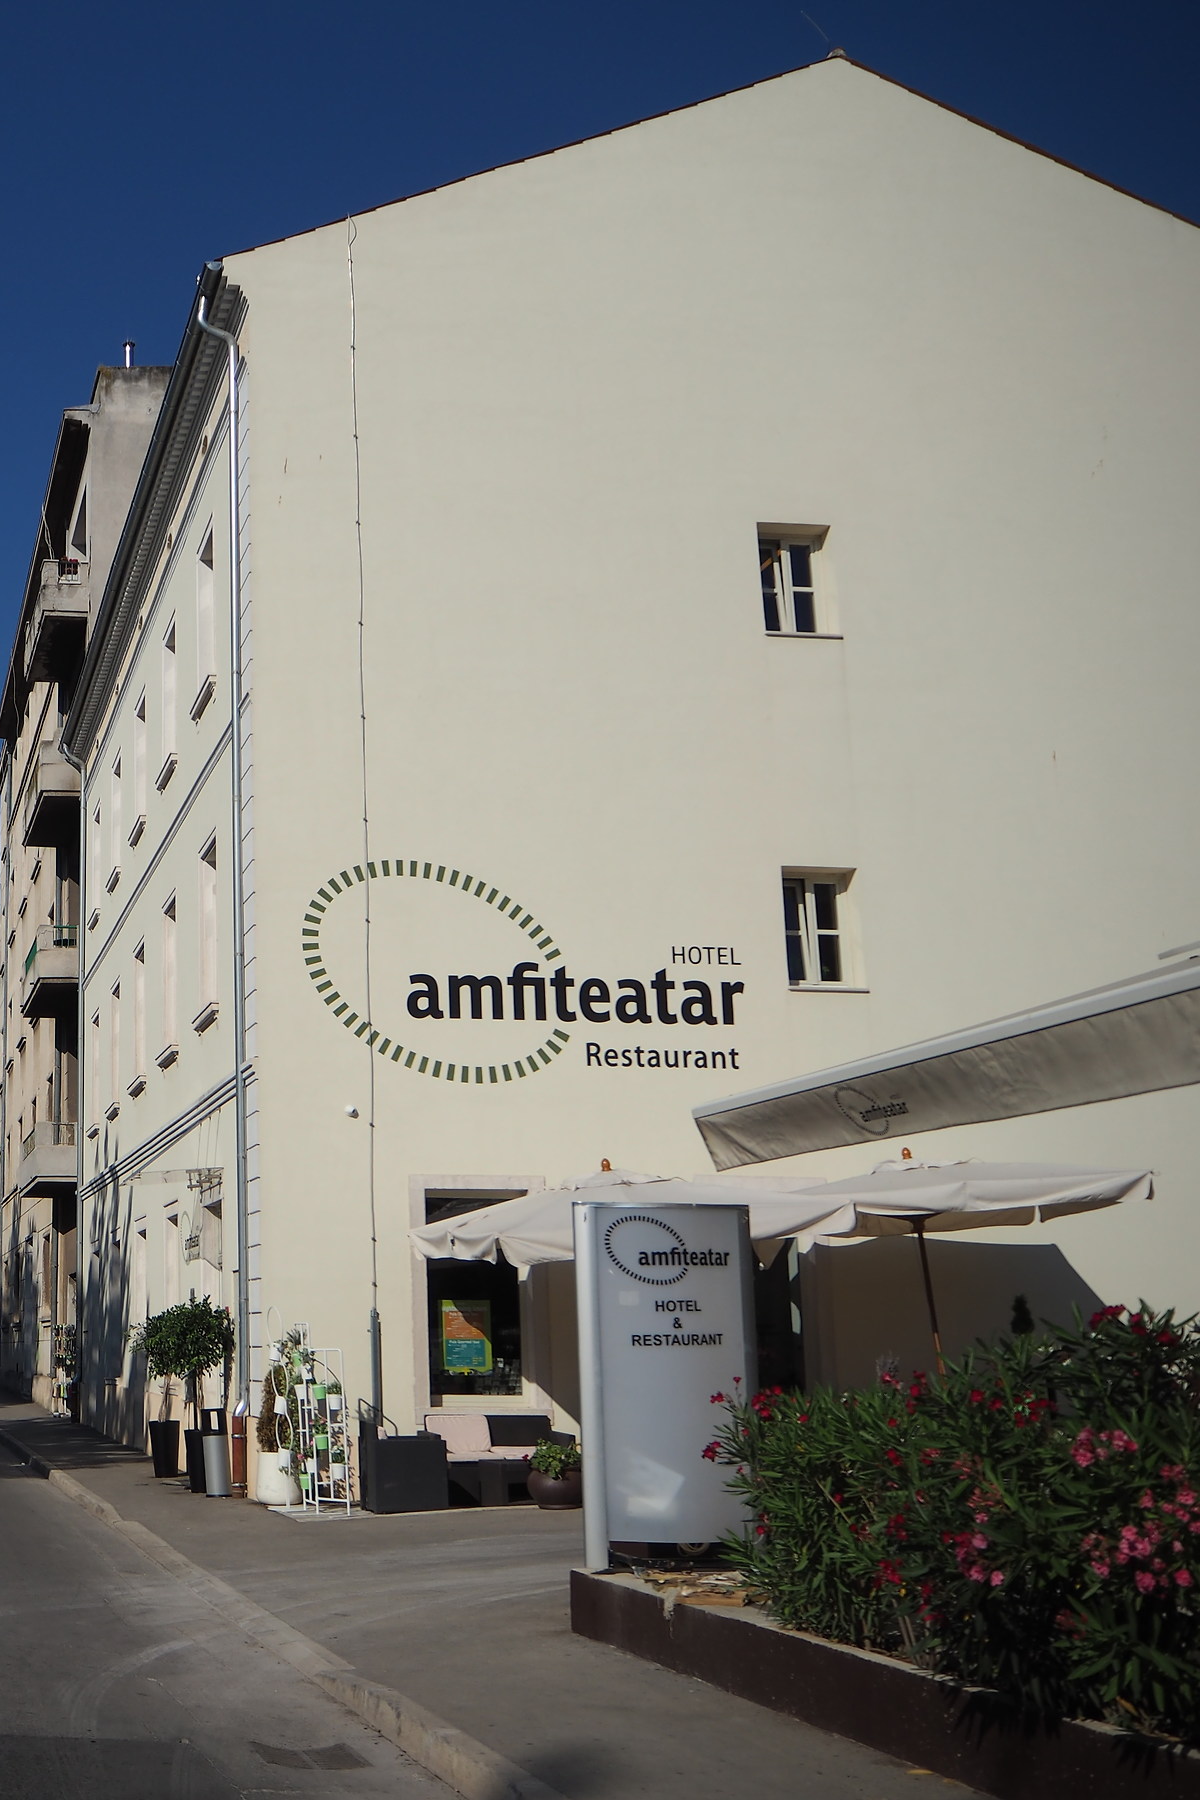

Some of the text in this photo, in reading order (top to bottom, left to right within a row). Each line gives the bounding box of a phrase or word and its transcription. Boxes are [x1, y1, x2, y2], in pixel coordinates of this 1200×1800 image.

[671, 946, 742, 965] HOTEL
[406, 961, 745, 1026] amfiteatar
[585, 1042, 740, 1070] Restaurant
[638, 1247, 730, 1266] amfiteatar
[655, 1300, 702, 1312] HOTEL
[672, 1317, 682, 1329] &
[631, 1334, 723, 1346] RESTAURANT
